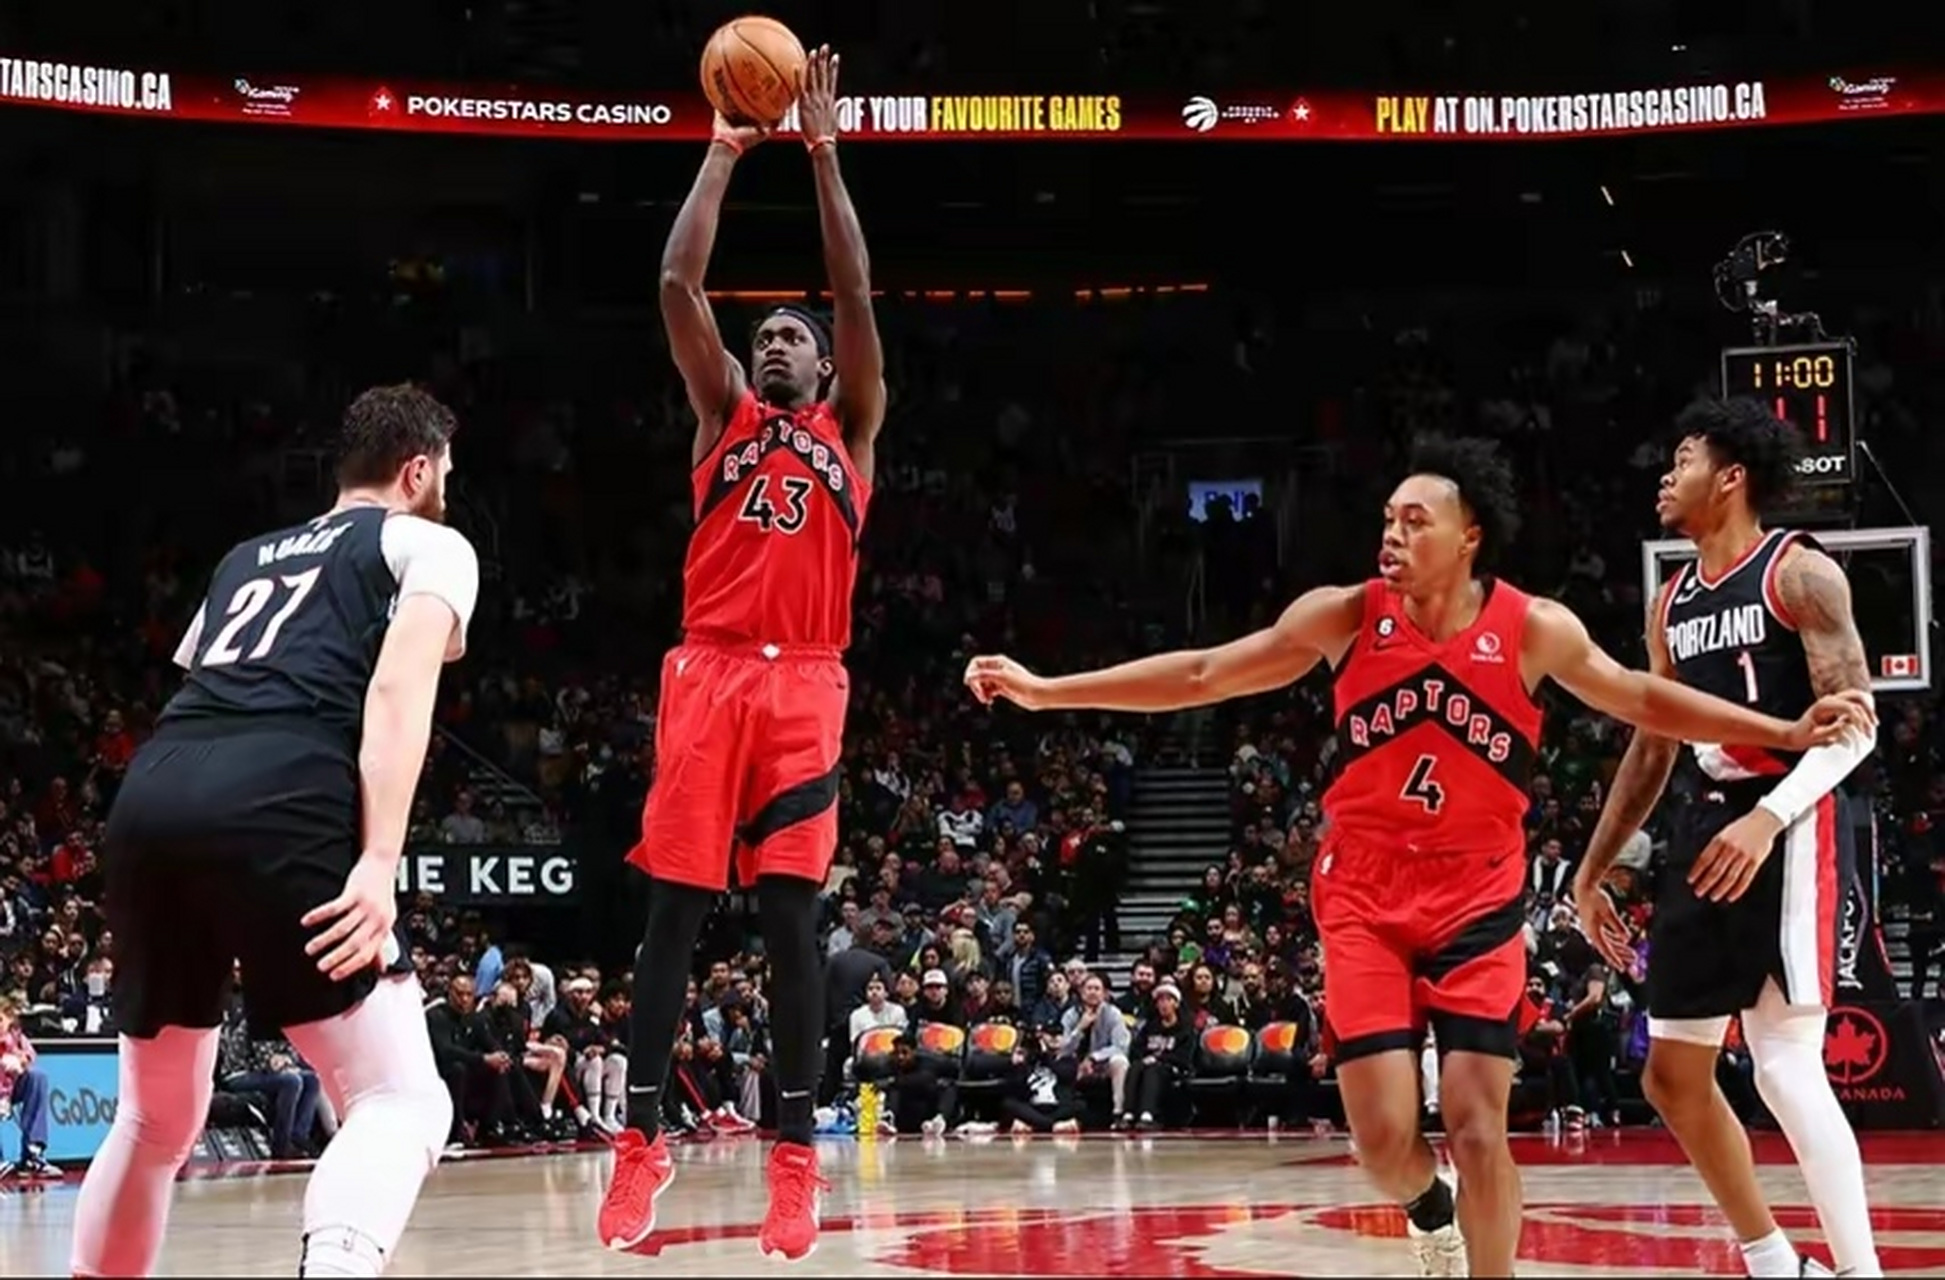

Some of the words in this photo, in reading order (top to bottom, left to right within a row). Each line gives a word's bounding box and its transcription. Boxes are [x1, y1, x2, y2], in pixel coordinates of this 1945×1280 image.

[0, 58, 171, 110] TARSCASINO.CA
[1376, 97, 1429, 133] PLAY
[1434, 97, 1460, 132] AT
[1464, 82, 1766, 133] ON.POKERSTARSCASINO.CA
[408, 97, 572, 122] POKERSTARS
[577, 104, 671, 124] CASINO
[835, 96, 865, 132] OF
[869, 97, 928, 132] YOUR
[931, 97, 1046, 132] FAVOURITE
[1050, 97, 1121, 131] GAMES
[1754, 356, 1835, 388] 11:00
[723, 419, 843, 491] RAPTORS
[1794, 456, 1846, 474] SOT
[738, 475, 813, 534] 43
[201, 566, 323, 666] 27
[1379, 618, 1393, 636] 6
[1665, 604, 1766, 664] PORTLAND
[1737, 651, 1759, 703] 1
[1350, 680, 1511, 762] RAPTORS
[1399, 755, 1445, 815] 4
[470, 856, 573, 893] KEG
[49, 1088, 118, 1126] GoDa
